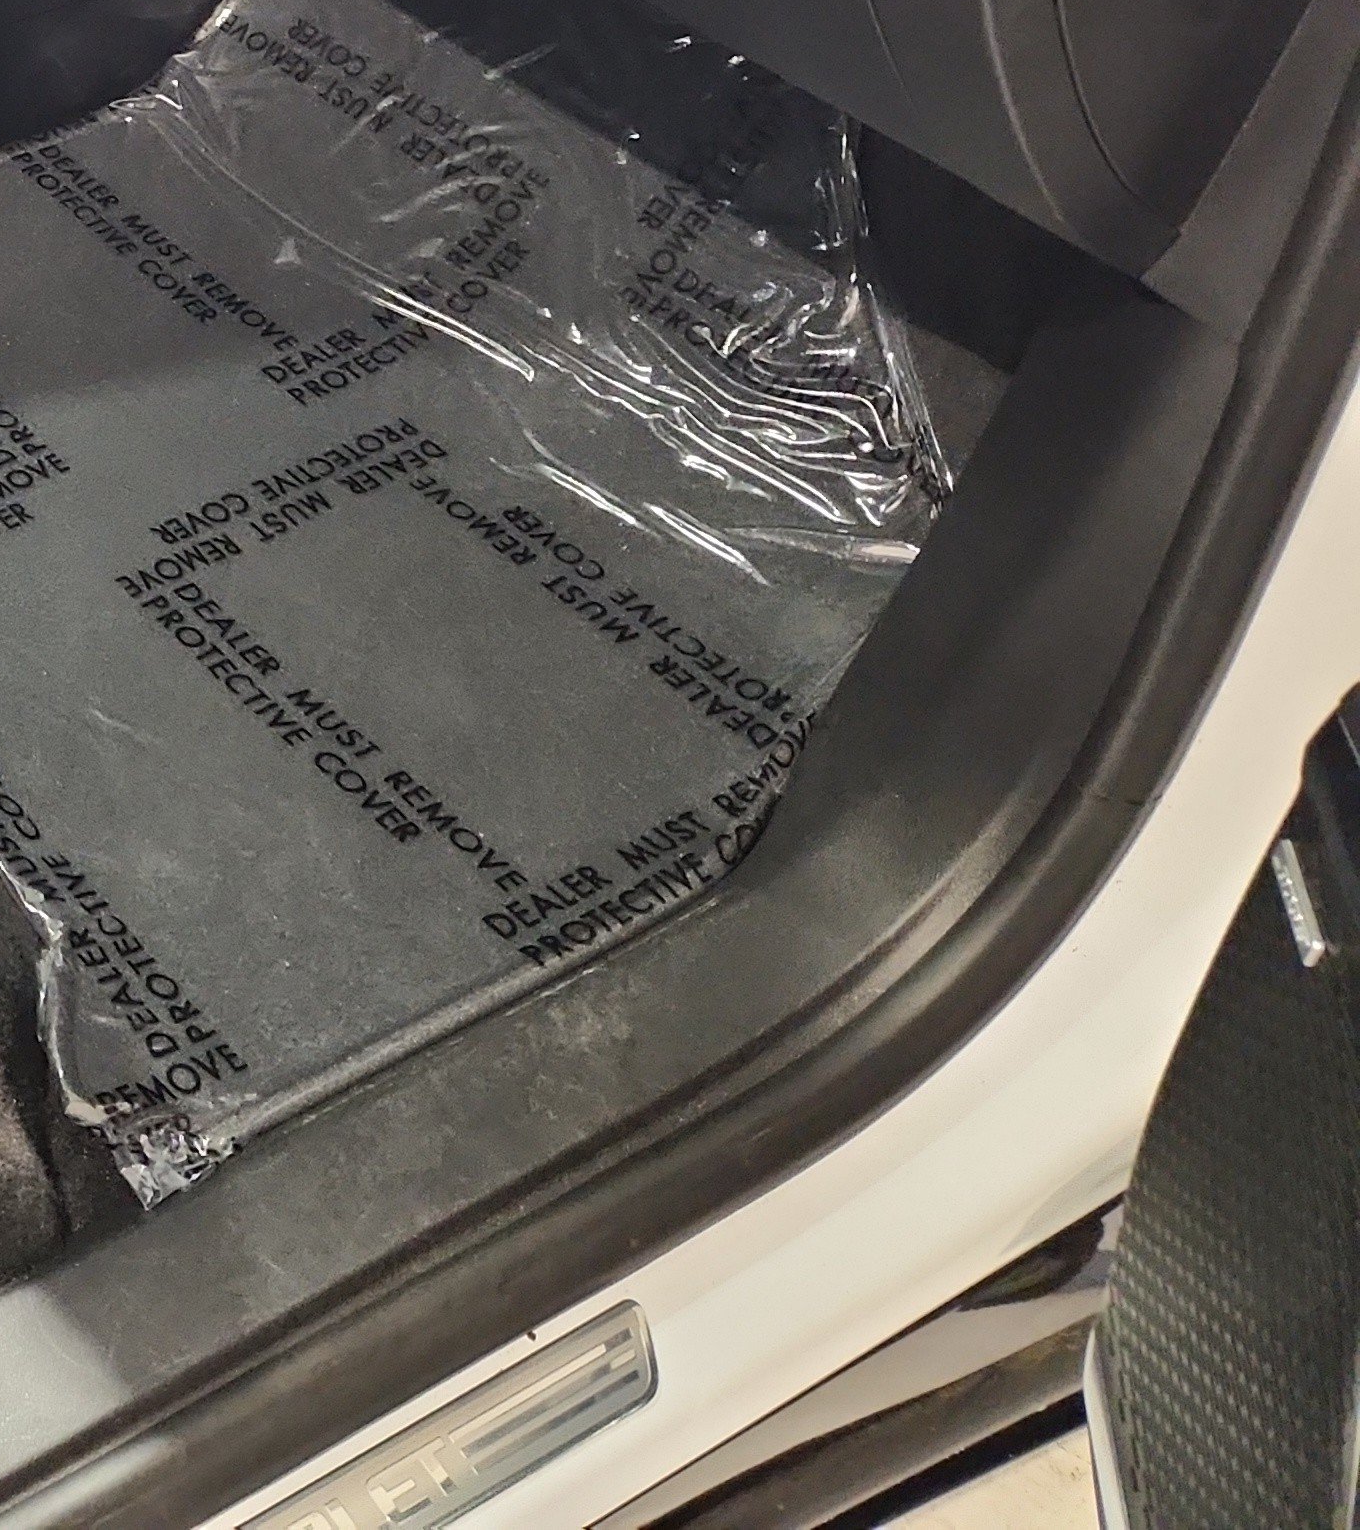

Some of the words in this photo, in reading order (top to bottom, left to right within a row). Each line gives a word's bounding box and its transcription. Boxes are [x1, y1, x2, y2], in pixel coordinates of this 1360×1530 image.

[11, 151, 138, 256] PROTECTIVE
[138, 259, 217, 324] COVER
[39, 144, 120, 209] DEALER
[121, 213, 193, 266] MUST
[192, 272, 299, 352] REMOVE
[446, 239, 531, 314] COVER
[262, 328, 366, 384] DEALER
[251, 417, 419, 502] PROTECTIVE
[337, 439, 448, 495] DEALER
[149, 493, 249, 545] COVER
[249, 490, 332, 542] MUST
[410, 474, 537, 566] REMOVE
[502, 505, 606, 581] COVER
[115, 534, 243, 599] REMOVE
[540, 575, 640, 643] MUST
[142, 595, 313, 748] PROTECTIVE
[314, 751, 422, 844] COVER
[174, 582, 282, 676] DEALER
[287, 688, 381, 760] MUST
[384, 770, 528, 893] REMOVE
[649, 654, 779, 750] DEALER
[482, 865, 613, 940] DEALER
[616, 811, 711, 871] MUST
[518, 851, 713, 966] PROTECTIVE
[41, 853, 217, 1044] PROTECTIVE
[68, 927, 180, 1058] DEALER
